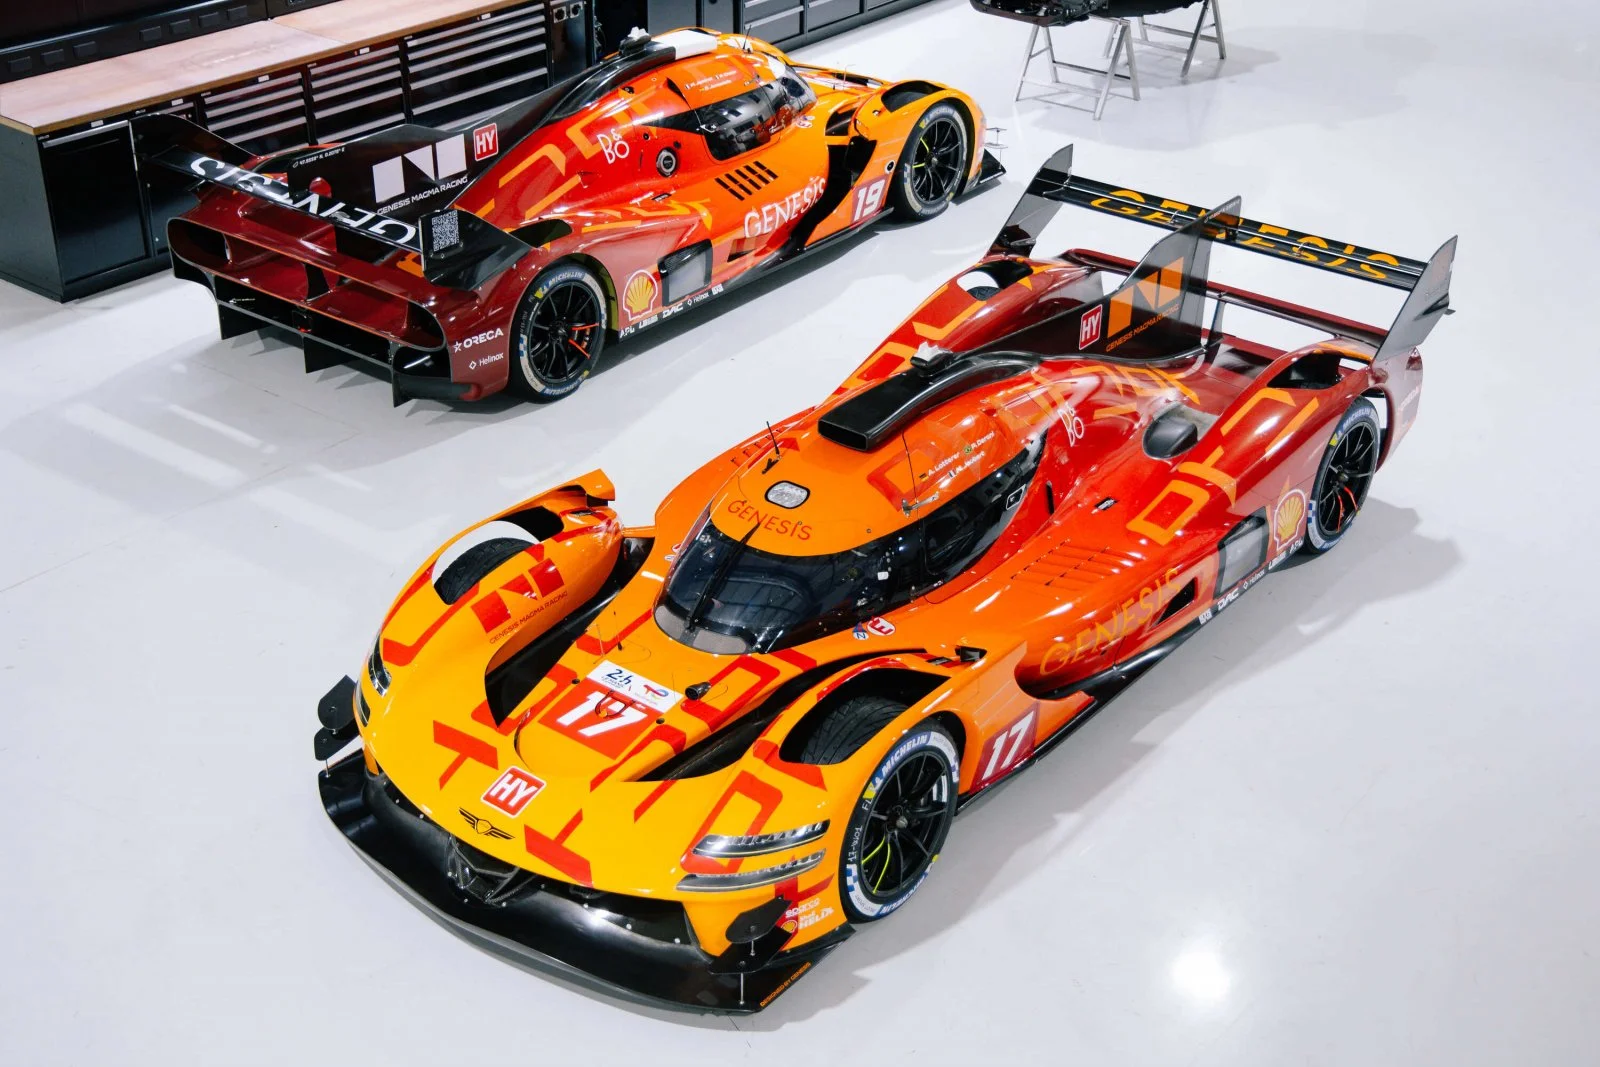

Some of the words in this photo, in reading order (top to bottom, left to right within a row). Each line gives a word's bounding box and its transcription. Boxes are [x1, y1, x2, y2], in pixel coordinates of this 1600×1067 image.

[475, 130, 496, 155] HY
[377, 197, 411, 216] GENESIS
[411, 186, 440, 204] MAGMA
[440, 175, 469, 193] RACING
[744, 177, 826, 238] GENESIS
[853, 178, 886, 222] 19
[463, 328, 504, 349] ORECA
[1081, 311, 1101, 343] HY
[1105, 330, 1133, 353] GENESIS
[1133, 317, 1157, 336] MAGMA
[479, 352, 504, 367] Helinox
[934, 451, 960, 472] Lotterer
[727, 499, 813, 541] GENESIS
[489, 621, 520, 645] GENESIS
[519, 606, 545, 625] MAGMA
[544, 590, 568, 609] RACING
[1039, 567, 1182, 676] GENESIS
[556, 690, 649, 737] 17
[881, 733, 929, 777] MICHELIN
[982, 710, 1035, 781] 17
[489, 773, 539, 807] HY
[760, 984, 785, 1007] DESIGNED
[783, 978, 792, 988] BY
[790, 962, 812, 980] GENESIS
